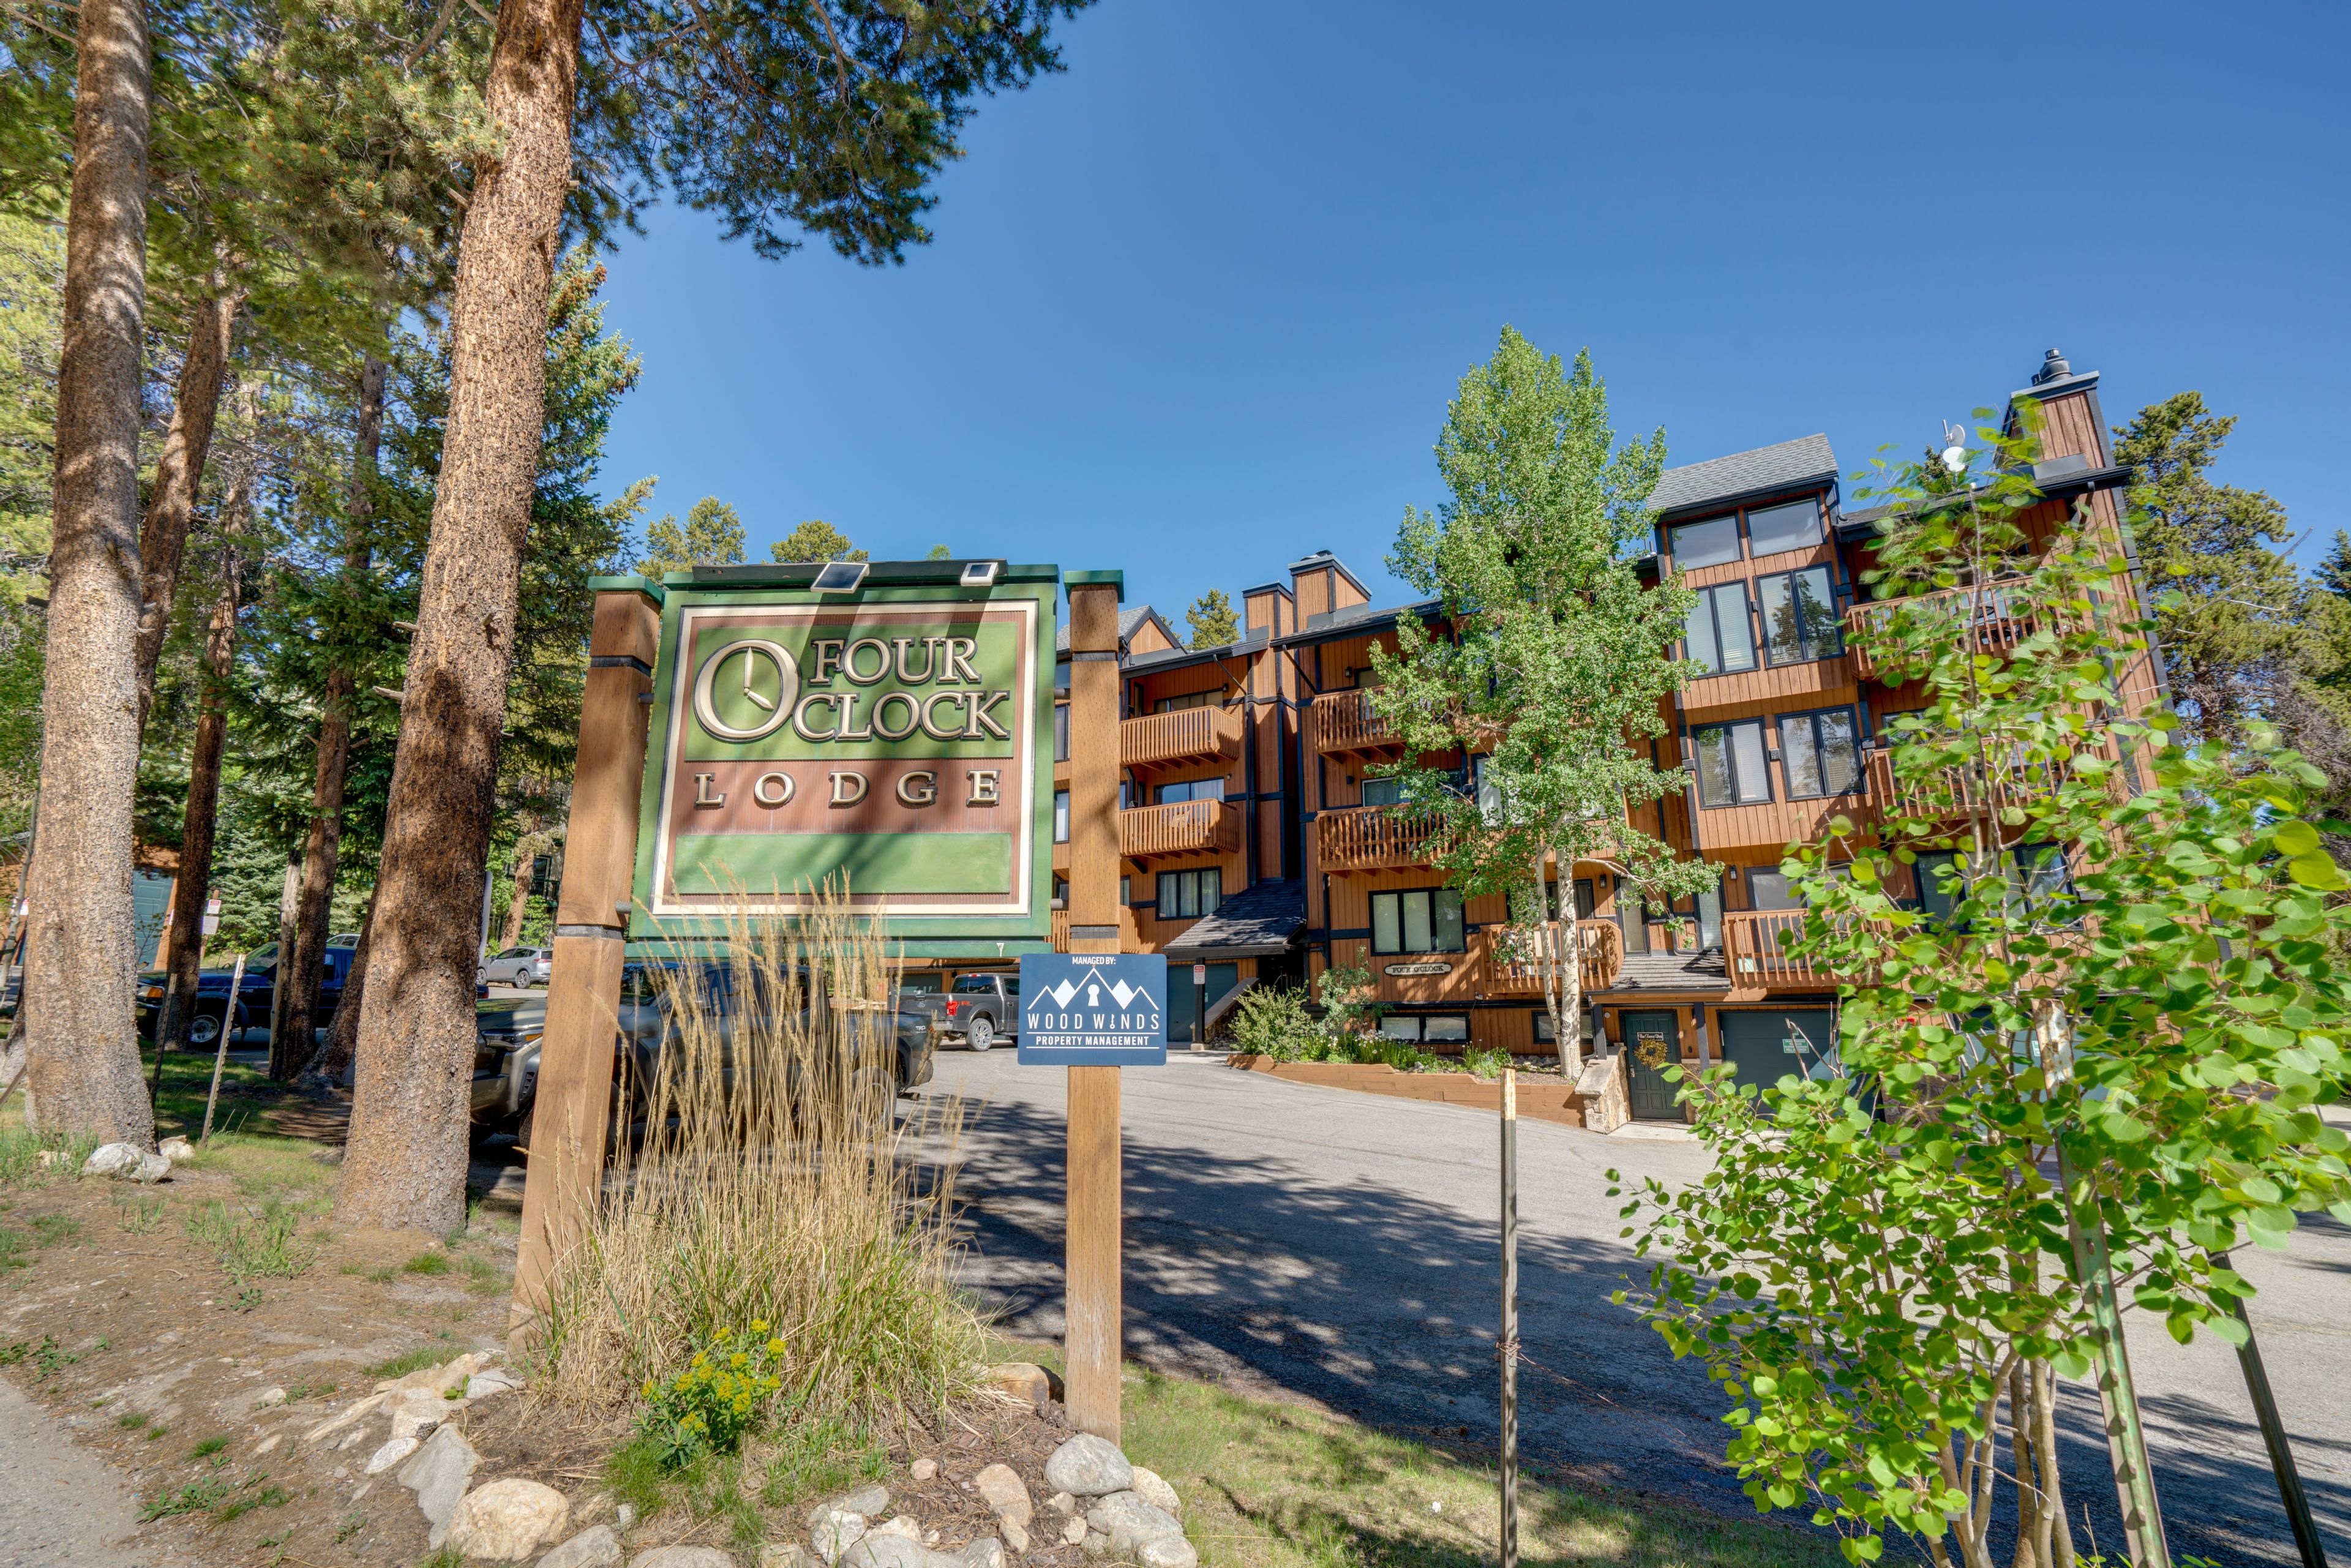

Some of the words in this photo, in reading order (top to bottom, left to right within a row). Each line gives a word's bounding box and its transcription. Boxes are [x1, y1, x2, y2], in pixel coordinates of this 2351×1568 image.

[808, 637, 981, 686] FOUR
[792, 690, 1010, 743] CLOCK
[694, 770, 1001, 808] LODGE
[1072, 956, 1104, 965] MANAGED
[1106, 956, 1116, 965] BY:
[1027, 1013, 1082, 1029] WOOD
[1036, 1036, 1082, 1046] PROPERTY
[1085, 1036, 1149, 1046] MANAGEMENT
